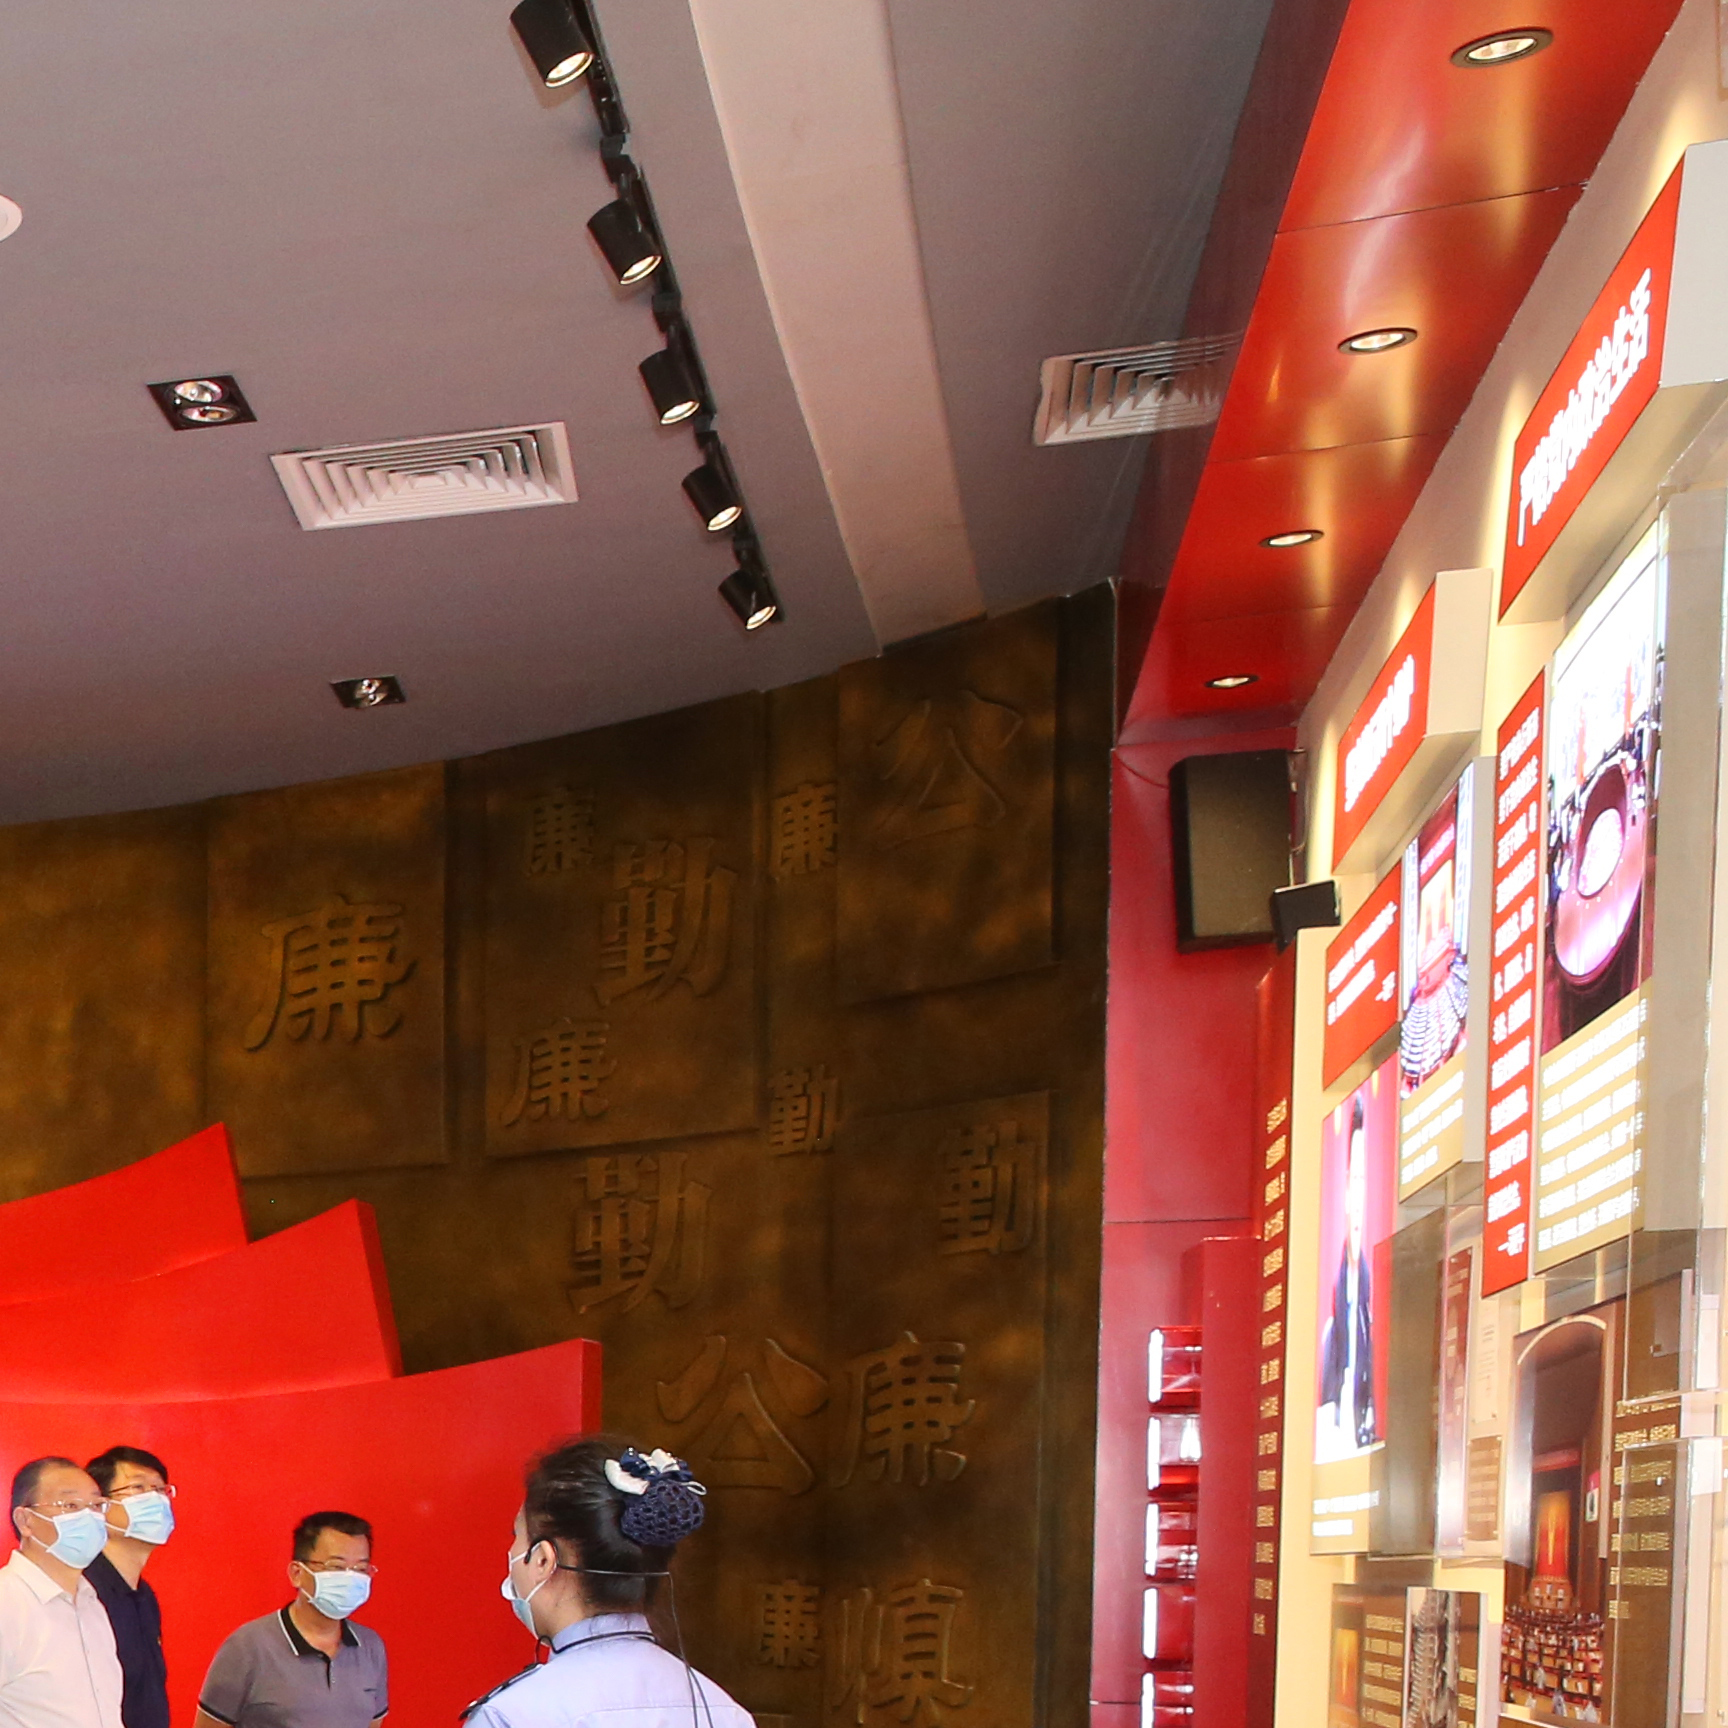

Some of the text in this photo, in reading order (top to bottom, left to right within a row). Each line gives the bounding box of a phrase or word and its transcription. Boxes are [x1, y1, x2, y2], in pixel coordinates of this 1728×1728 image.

[245, 892, 418, 1052] 廉
[597, 836, 741, 1008] 勤
[500, 1015, 617, 1128] 廉
[568, 1152, 713, 1315] 勤
[657, 1334, 829, 1497] 公
[829, 1330, 976, 1490] 廉
